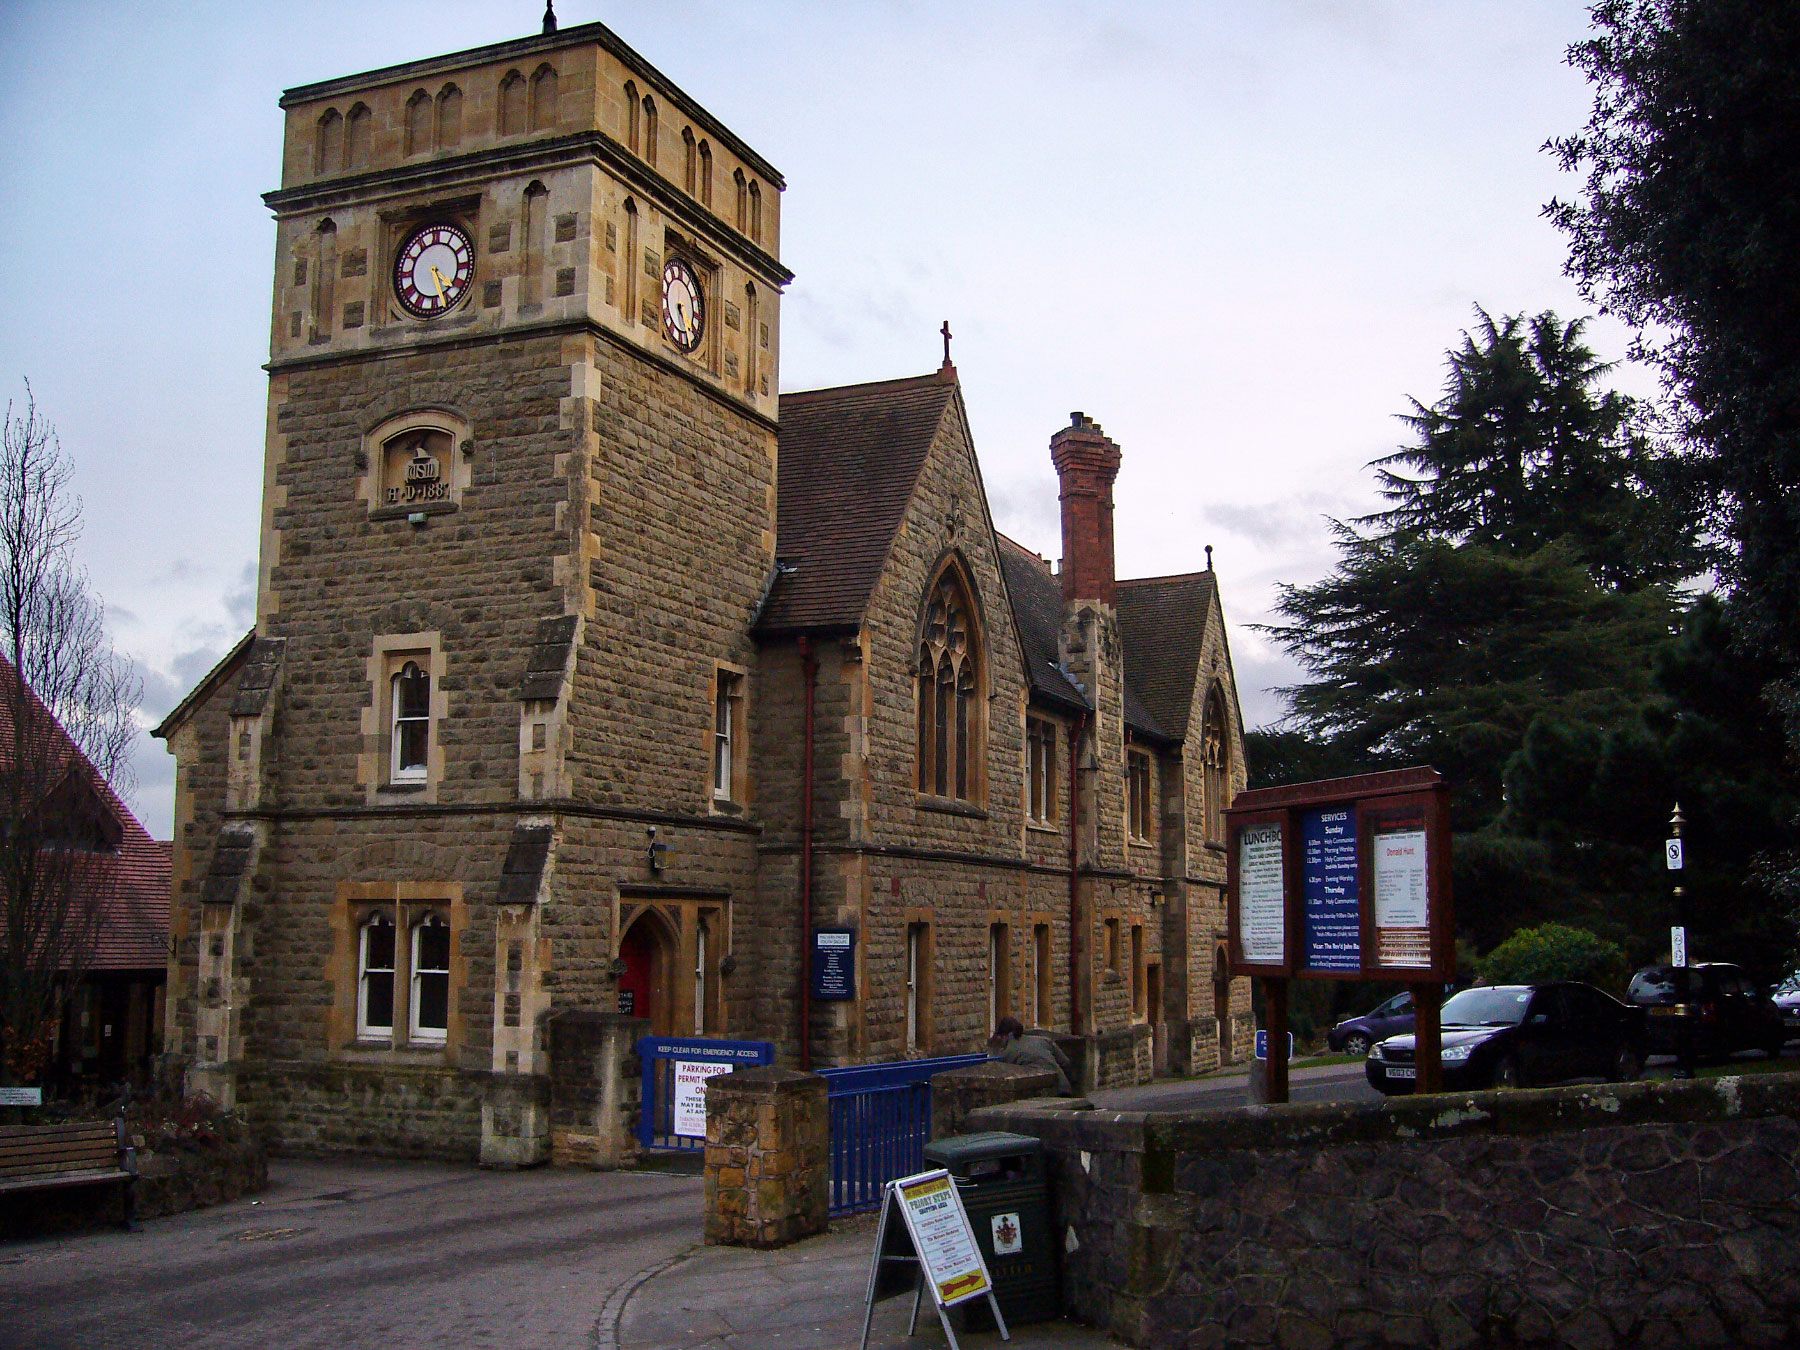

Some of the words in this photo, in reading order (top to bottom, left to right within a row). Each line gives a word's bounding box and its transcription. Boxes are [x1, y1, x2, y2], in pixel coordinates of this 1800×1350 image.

[1321, 812, 1347, 822] SERVICES
[1325, 825, 1343, 835] Sunday
[1387, 848, 1402, 856] Donald
[1324, 886, 1345, 895] Thursday
[703, 1048, 735, 1056] EMERGENCY
[682, 1064, 711, 1074] PARKING
[713, 1066, 726, 1074] FOR
[678, 1074, 700, 1083] PERMIT
[909, 1196, 932, 1210] PRIORY
[932, 1190, 952, 1203] STEPS
